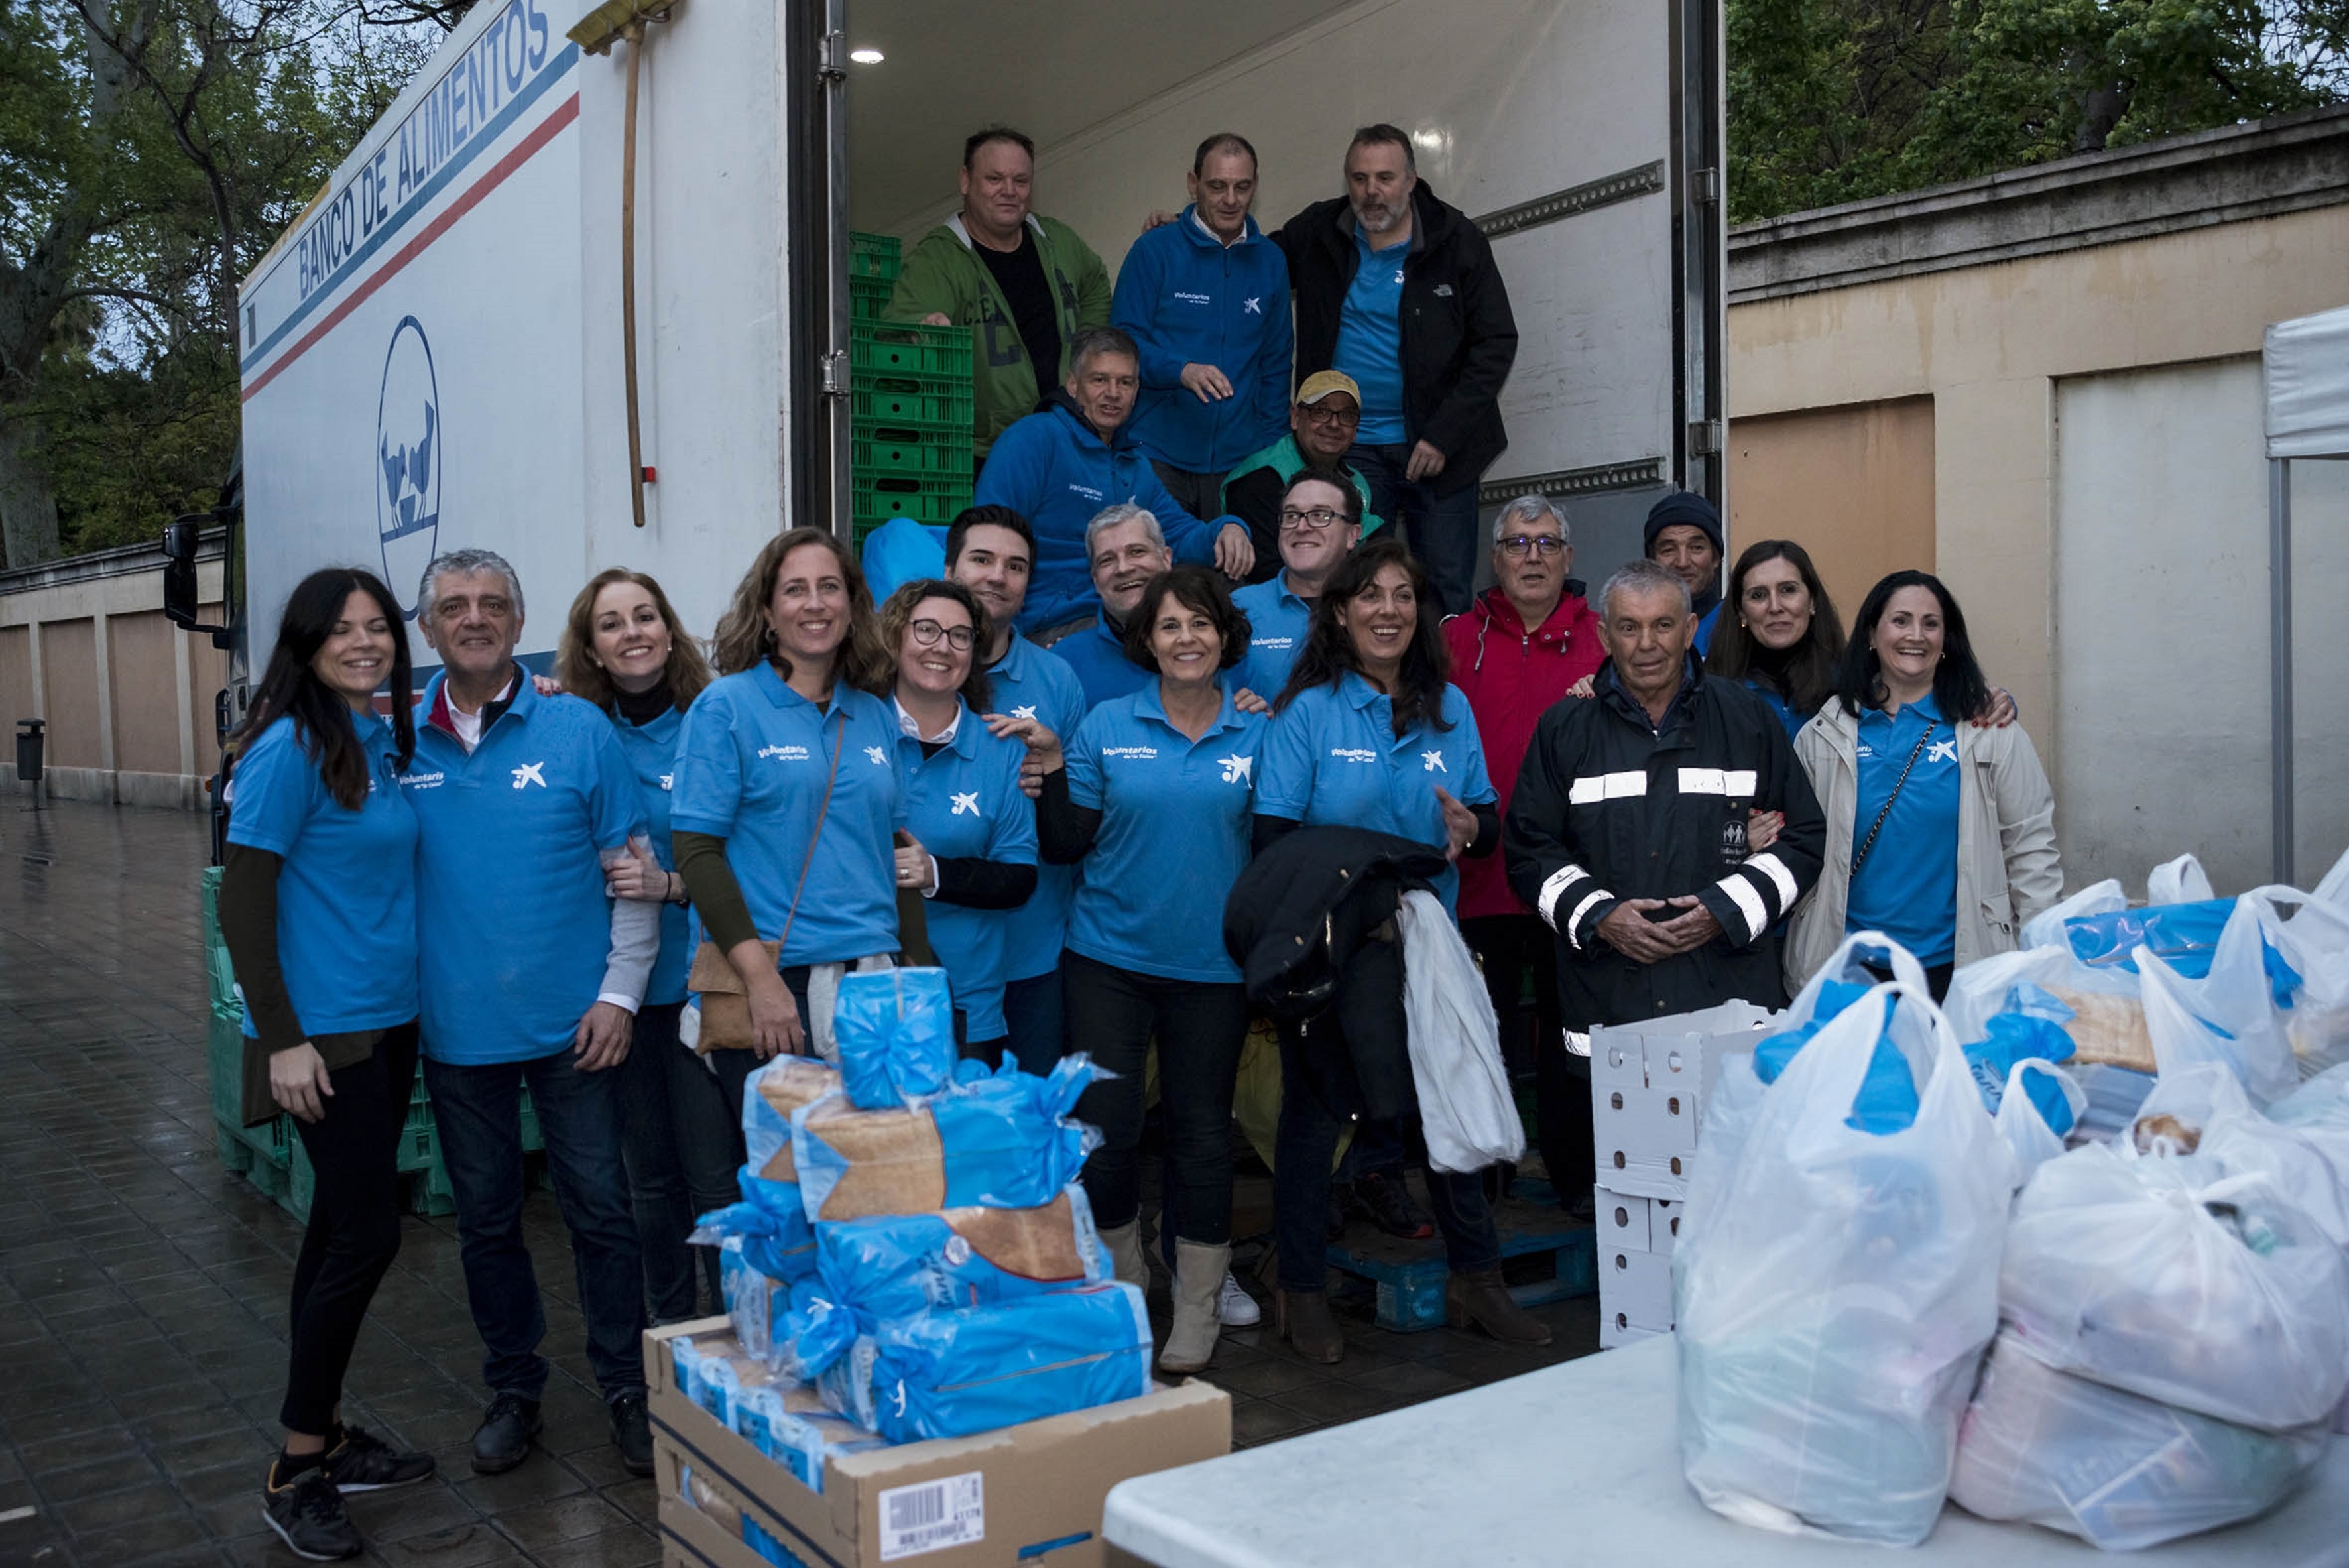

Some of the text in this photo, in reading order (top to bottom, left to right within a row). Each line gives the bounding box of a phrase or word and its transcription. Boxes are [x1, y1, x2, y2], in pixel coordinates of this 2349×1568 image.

[299, 0, 548, 300] BANCO DE ALIMENTOS
[1251, 636, 1293, 646] Voluntarios
[1102, 746, 1158, 756] Voluntarios
[399, 771, 444, 785] Voluntaris
